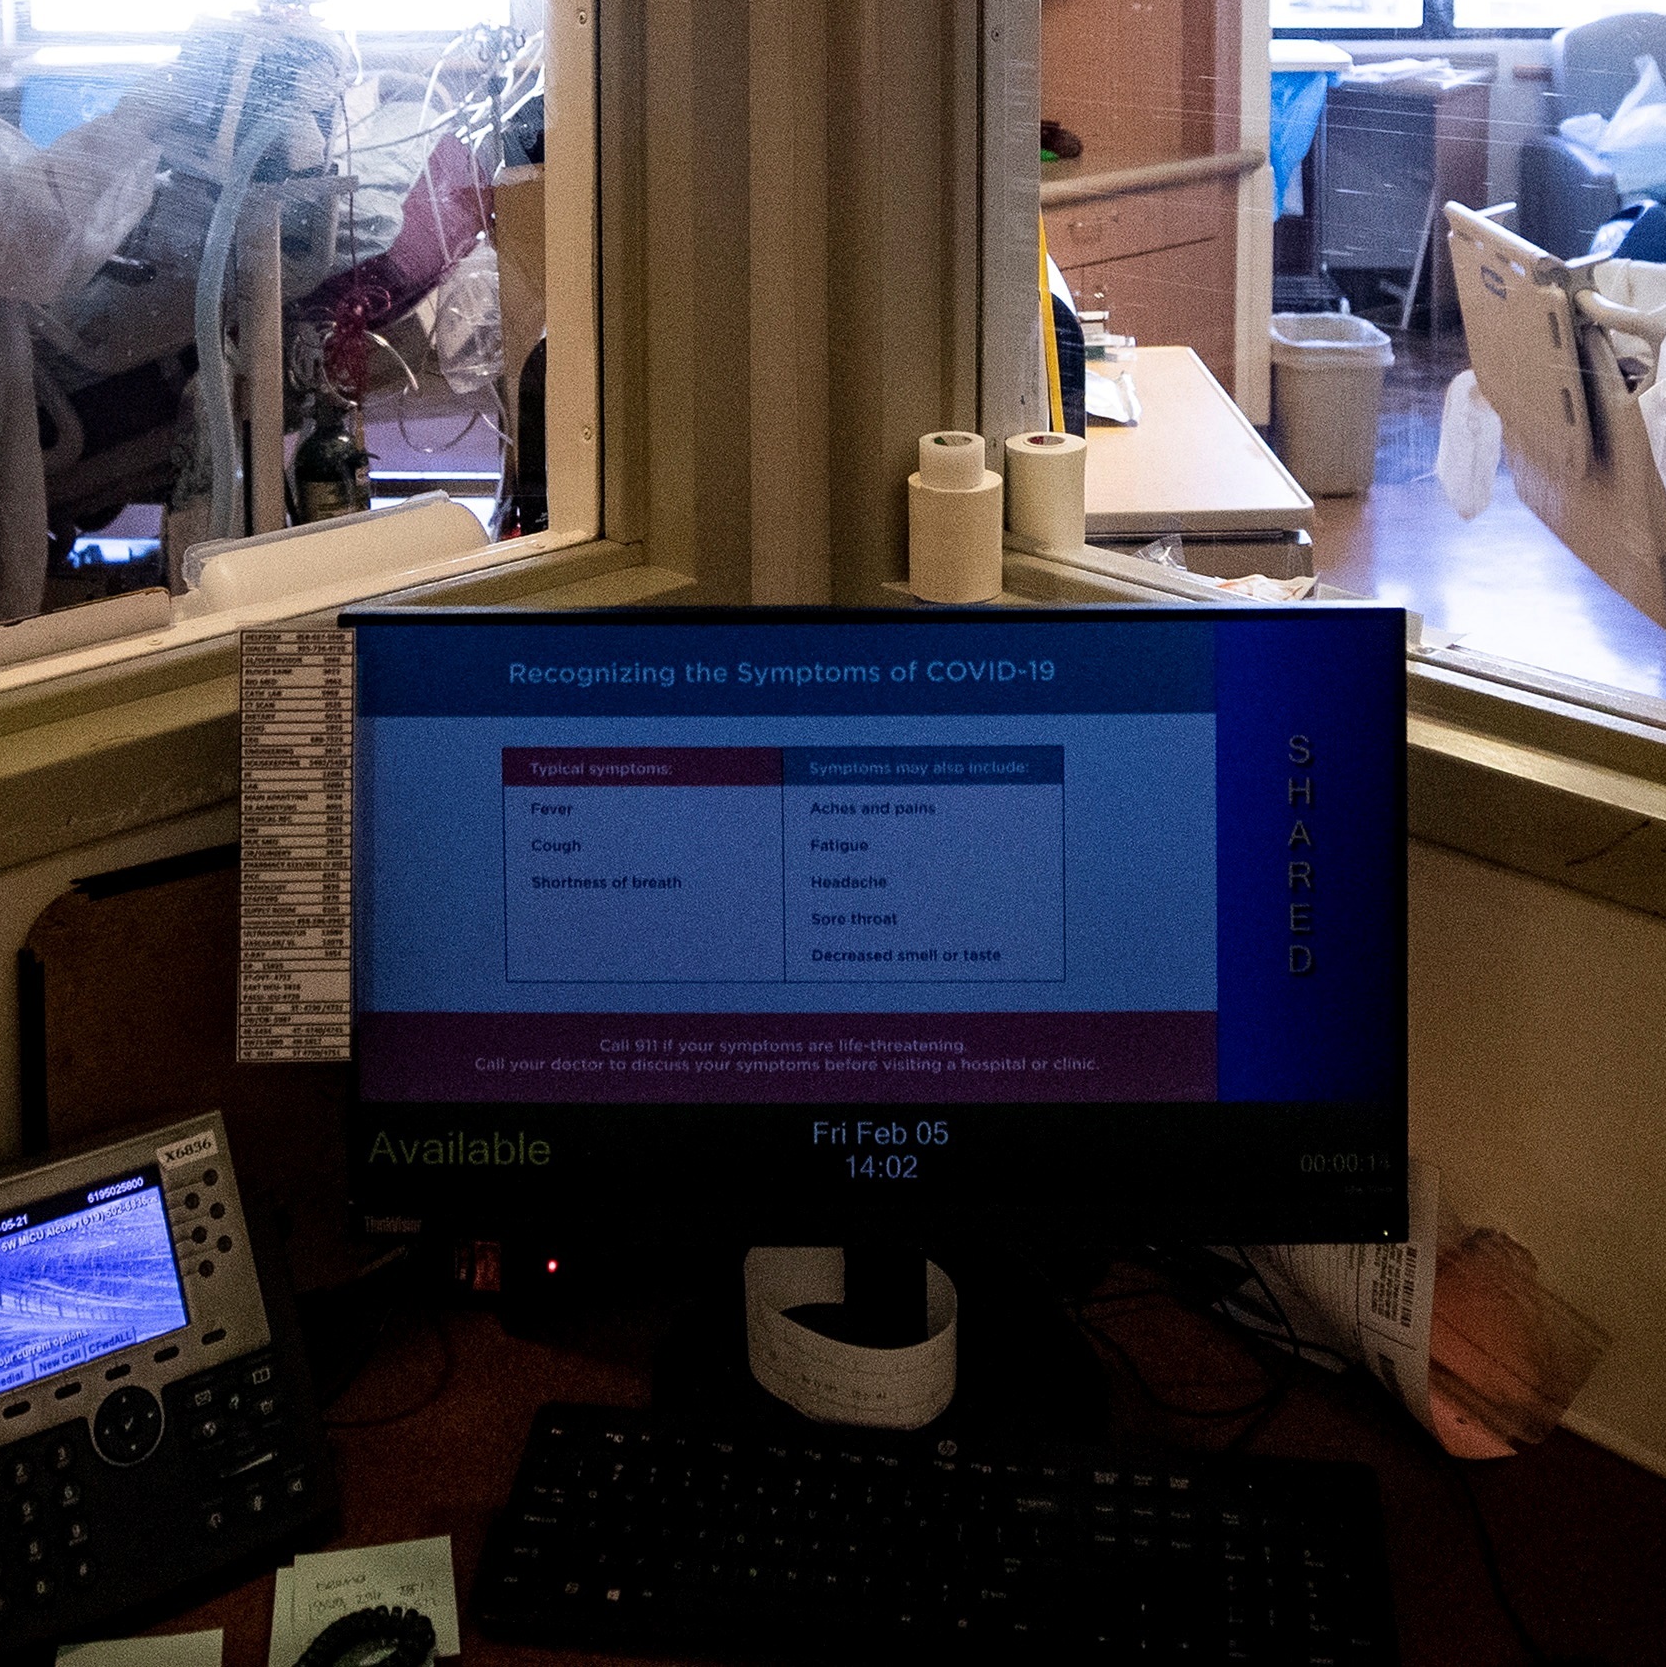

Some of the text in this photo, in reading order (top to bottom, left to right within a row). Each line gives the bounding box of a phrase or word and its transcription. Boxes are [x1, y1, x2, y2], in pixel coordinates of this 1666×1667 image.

[508, 660, 1056, 687] Recognizing the Symptoms of COVID-19
[530, 762, 673, 778] Typical symptoms:
[809, 761, 1030, 777] Symptoms may also include:
[531, 803, 573, 816] Fever
[810, 802, 936, 817] Aches and pains
[531, 839, 581, 854] Cough
[810, 839, 869, 854] Fatigue
[1286, 734, 1313, 975] SHARED
[532, 876, 682, 890] Shortness of breath
[810, 876, 887, 889] Headache
[811, 913, 898, 926] Sore throat
[811, 948, 1002, 962] Decreased smell or taste
[599, 1039, 967, 1055] Call 911 if your symptoms are life-threatening.
[474, 1058, 1100, 1075] Call your doctor to discuss your symptoms before visiting a hospital or clinic.
[812, 1121, 950, 1146] Fri Feb 05
[164, 1138, 212, 1163] X6836
[367, 1130, 552, 1166] Available
[846, 1154, 919, 1179] 14:02
[87, 1177, 145, 1204] 6195025800
[17, 1231, 44, 1251] MICU
[46, 1219, 79, 1240] Alcove
[88, 1331, 132, 1355] CFwdALL
[39, 1349, 82, 1372] New Call
